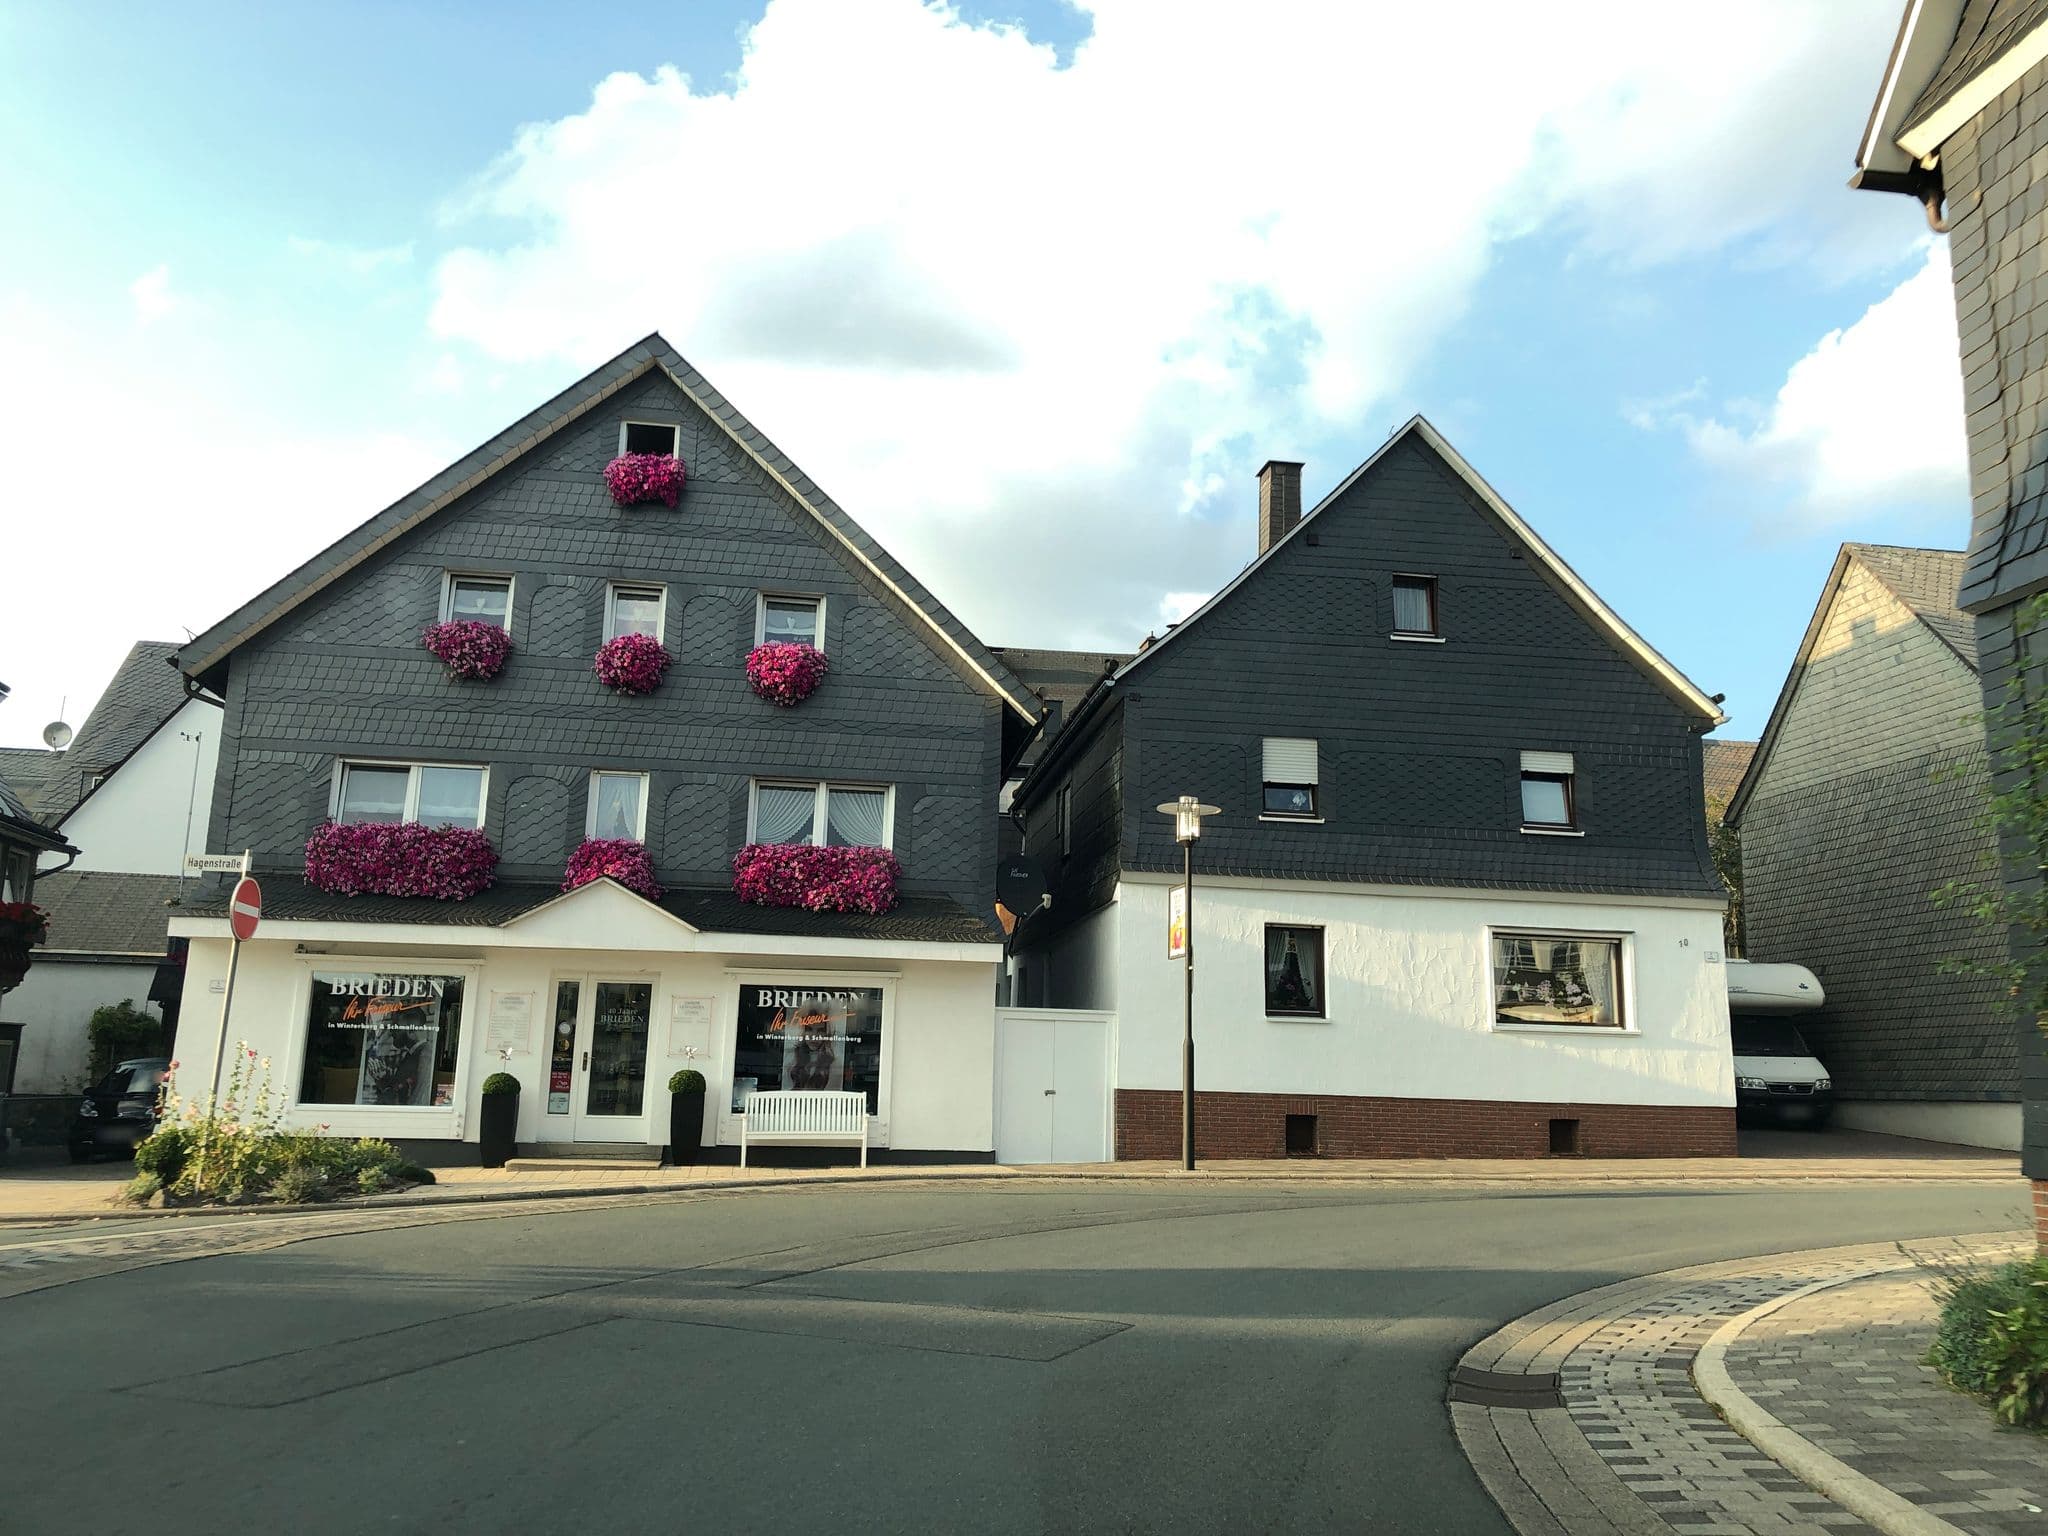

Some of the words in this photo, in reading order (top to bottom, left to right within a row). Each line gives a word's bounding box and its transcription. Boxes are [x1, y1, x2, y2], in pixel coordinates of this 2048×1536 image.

[188, 857, 242, 870] Hagenstraße
[1678, 938, 1689, 948] 10
[329, 977, 446, 998] BRIEDEN
[600, 1015, 644, 1023] BRIEDEN
[337, 1022, 378, 1030] Winterberg
[387, 1023, 440, 1032] Schmallenberg
[765, 1034, 804, 1042] Winterberg
[812, 1035, 862, 1043] Schmallenberg
